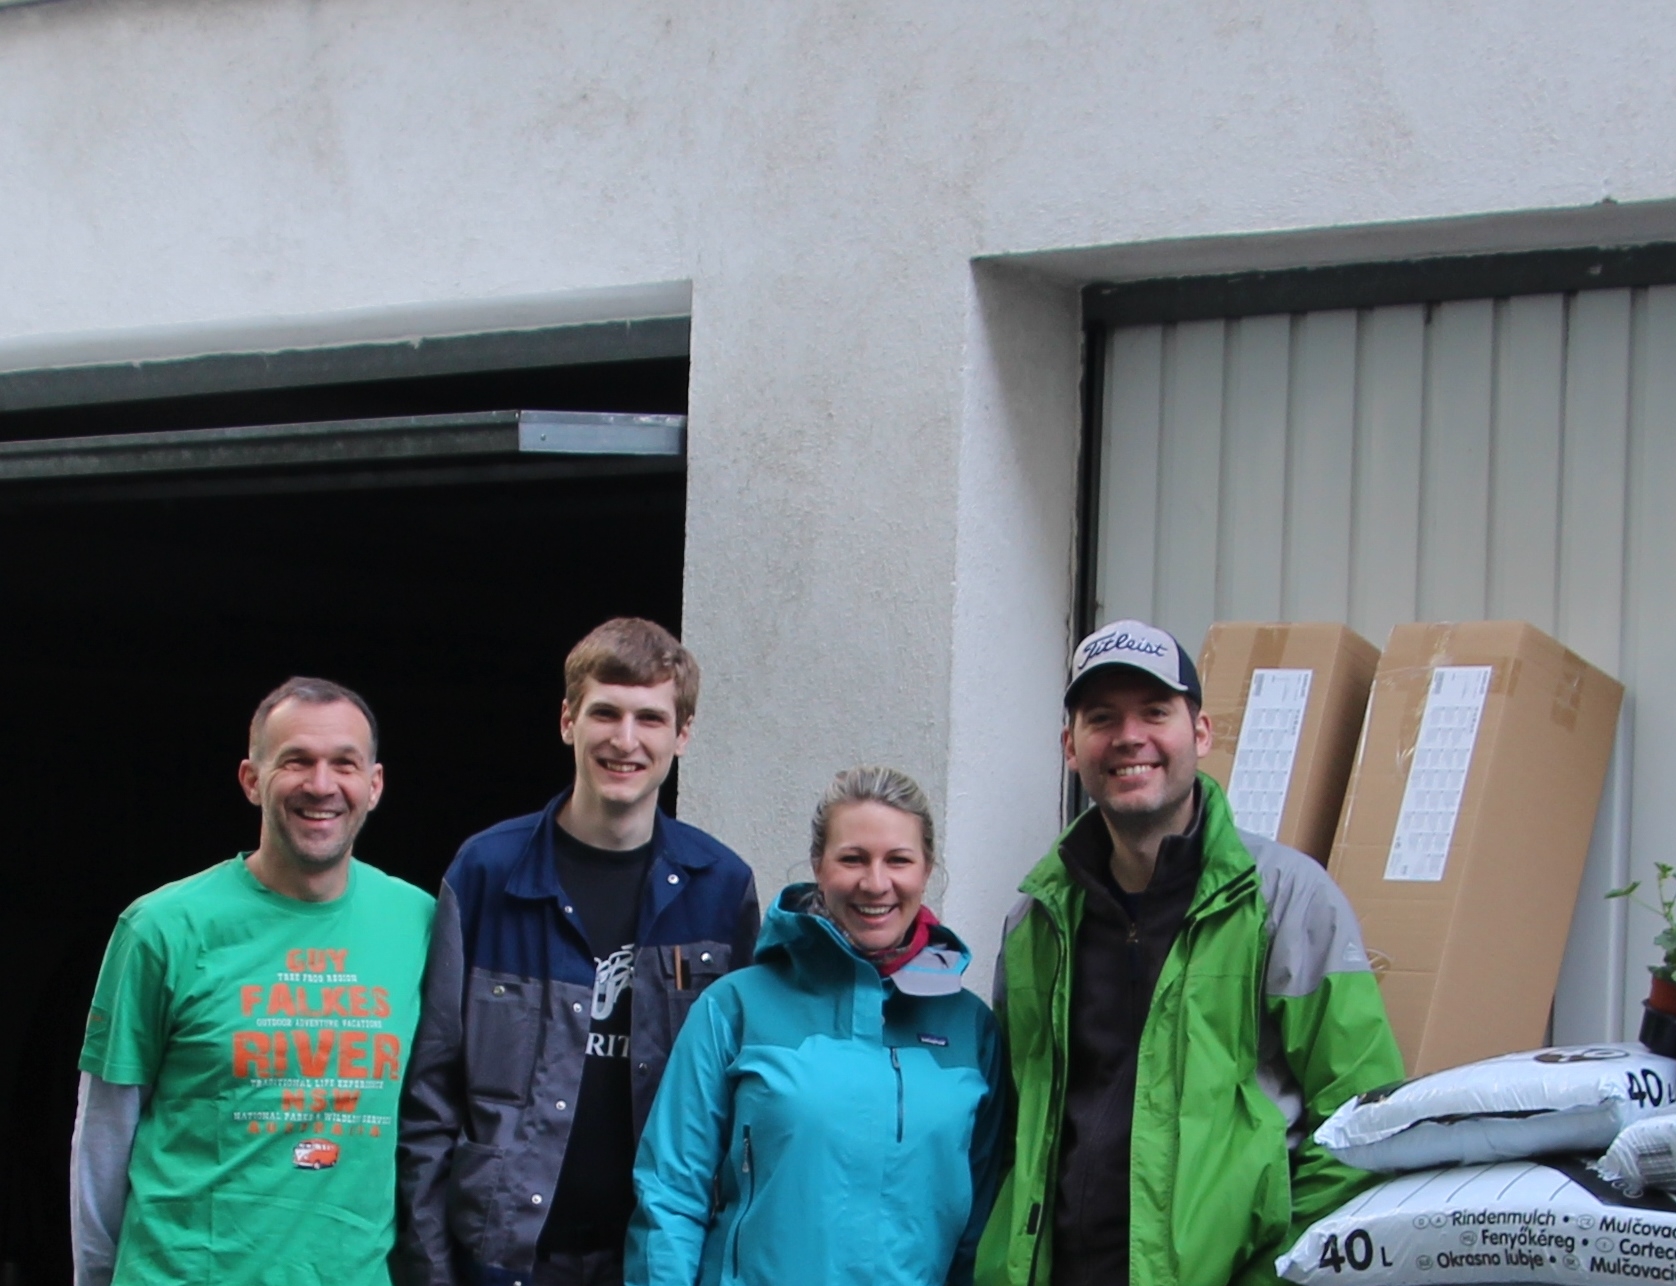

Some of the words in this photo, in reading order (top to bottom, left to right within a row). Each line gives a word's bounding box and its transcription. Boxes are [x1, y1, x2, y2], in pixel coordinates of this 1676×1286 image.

[1078, 631, 1168, 670] Titleist
[286, 948, 348, 973] GUY
[302, 974, 324, 983] FROG
[327, 974, 358, 983] REGION
[241, 983, 391, 1018] FALKES
[256, 1018, 292, 1027] OUTDOOR
[295, 1018, 338, 1028] ADVENTURE
[342, 1019, 383, 1028] VACATIONS
[233, 1029, 400, 1080] RIVER
[250, 1078, 312, 1089] TRADITIONAL
[314, 1078, 335, 1088] LIFE
[1626, 1068, 1663, 1108] 40
[282, 1088, 361, 1113] NSW
[233, 1111, 281, 1121] NATIONAL
[1452, 1208, 1556, 1227] Rindenmulch
[1319, 1228, 1373, 1273] 40
[1381, 1246, 1393, 1267] L
[1482, 1226, 1575, 1253] Fenyőkéreg
[1437, 1251, 1500, 1269] Okrasno
[1505, 1249, 1544, 1270] lubje
